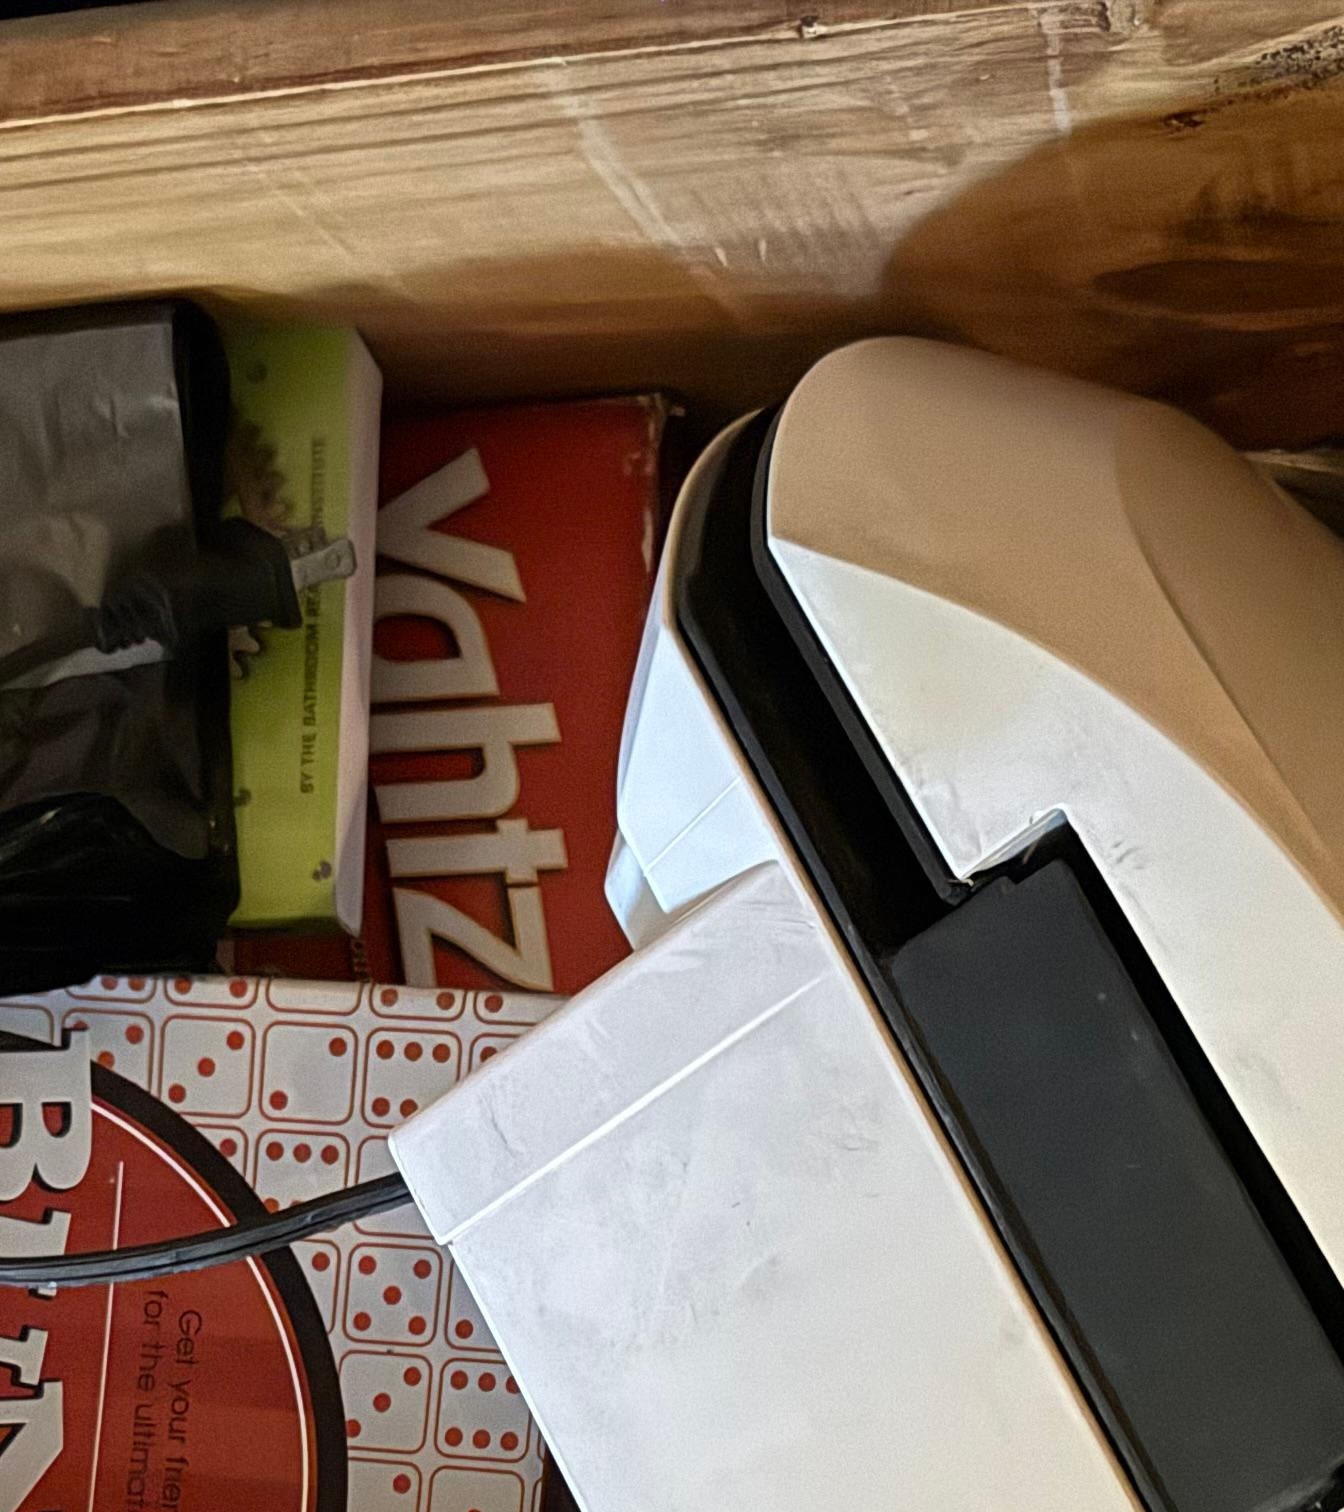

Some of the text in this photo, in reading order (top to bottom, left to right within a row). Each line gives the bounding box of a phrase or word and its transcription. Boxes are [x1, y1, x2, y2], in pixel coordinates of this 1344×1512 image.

[301, 737, 316, 766] THE
[300, 770, 313, 794] BY
[142, 1290, 169, 1327] for
[176, 1309, 203, 1365] Get
[136, 1344, 164, 1393] the
[166, 1380, 193, 1446] your
